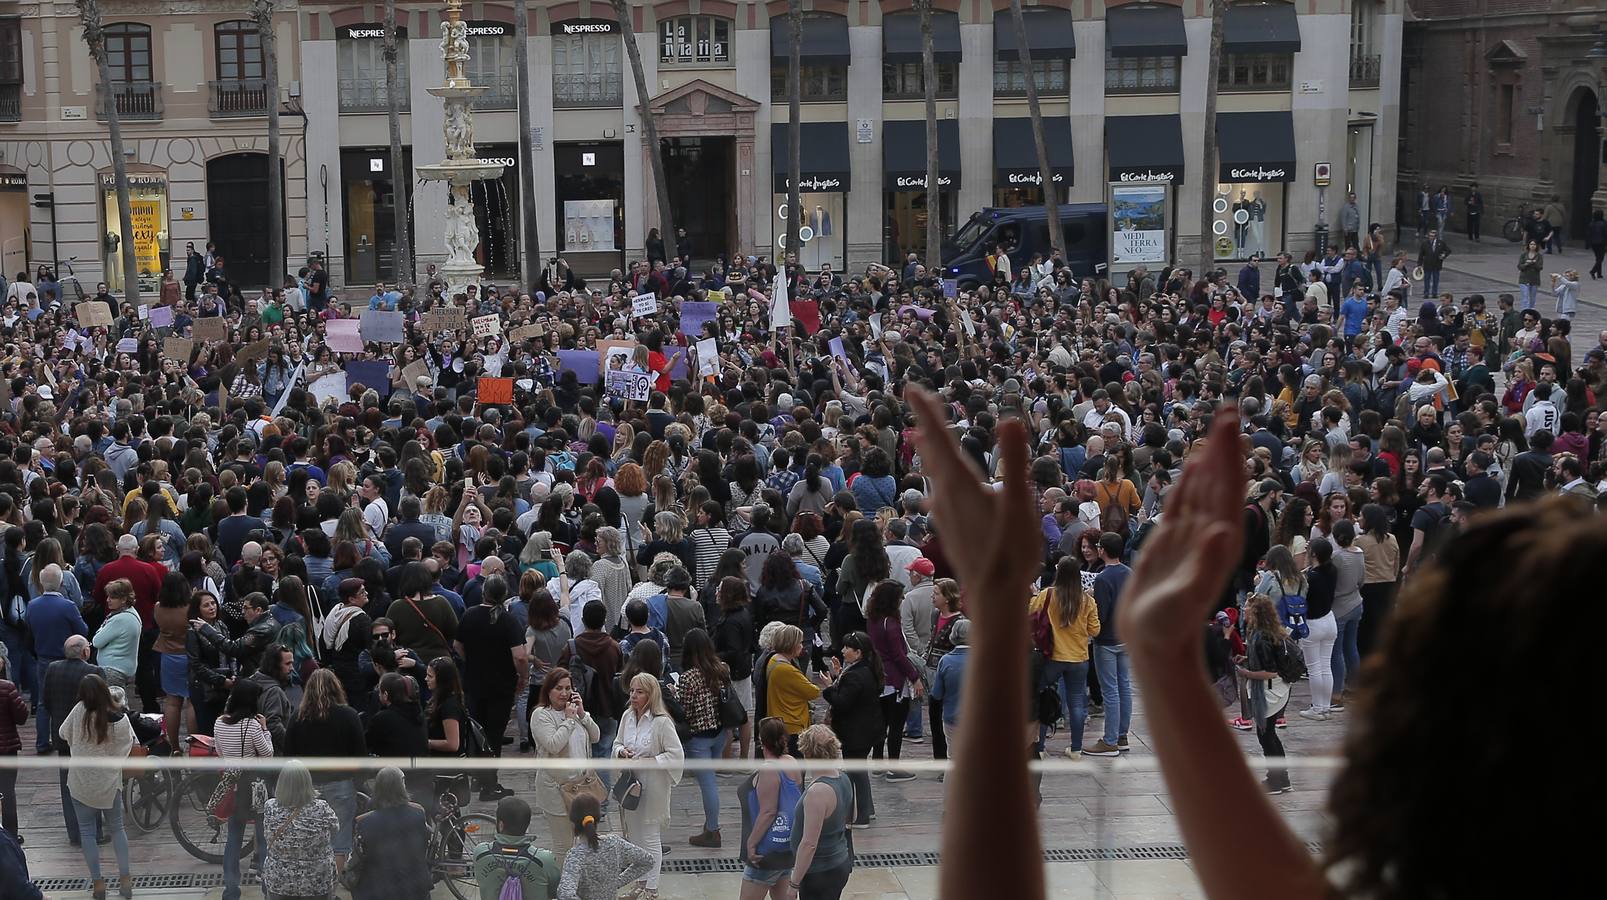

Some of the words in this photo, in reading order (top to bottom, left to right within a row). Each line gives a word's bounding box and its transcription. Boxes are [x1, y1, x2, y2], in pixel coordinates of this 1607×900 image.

[464, 26, 504, 35] ESPRESSO
[563, 23, 611, 34] NESPRESSO
[666, 21, 685, 36] La
[349, 29, 397, 39] NESPRES
[477, 157, 515, 167] RESSO
[1009, 173, 1017, 183] El
[1017, 173, 1035, 182] Corte
[1120, 173, 1129, 182] El
[1129, 173, 1147, 181] Corte
[1231, 168, 1240, 178] El
[1239, 168, 1258, 178] Corte
[799, 179, 813, 187] orte
[897, 176, 906, 187] El
[905, 176, 924, 186] Corte
[133, 230, 154, 244] exy
[1123, 232, 1145, 240] MEDI
[1130, 239, 1157, 247] TERRA
[1124, 246, 1142, 254] NEO
[1544, 409, 1554, 432] JUST
